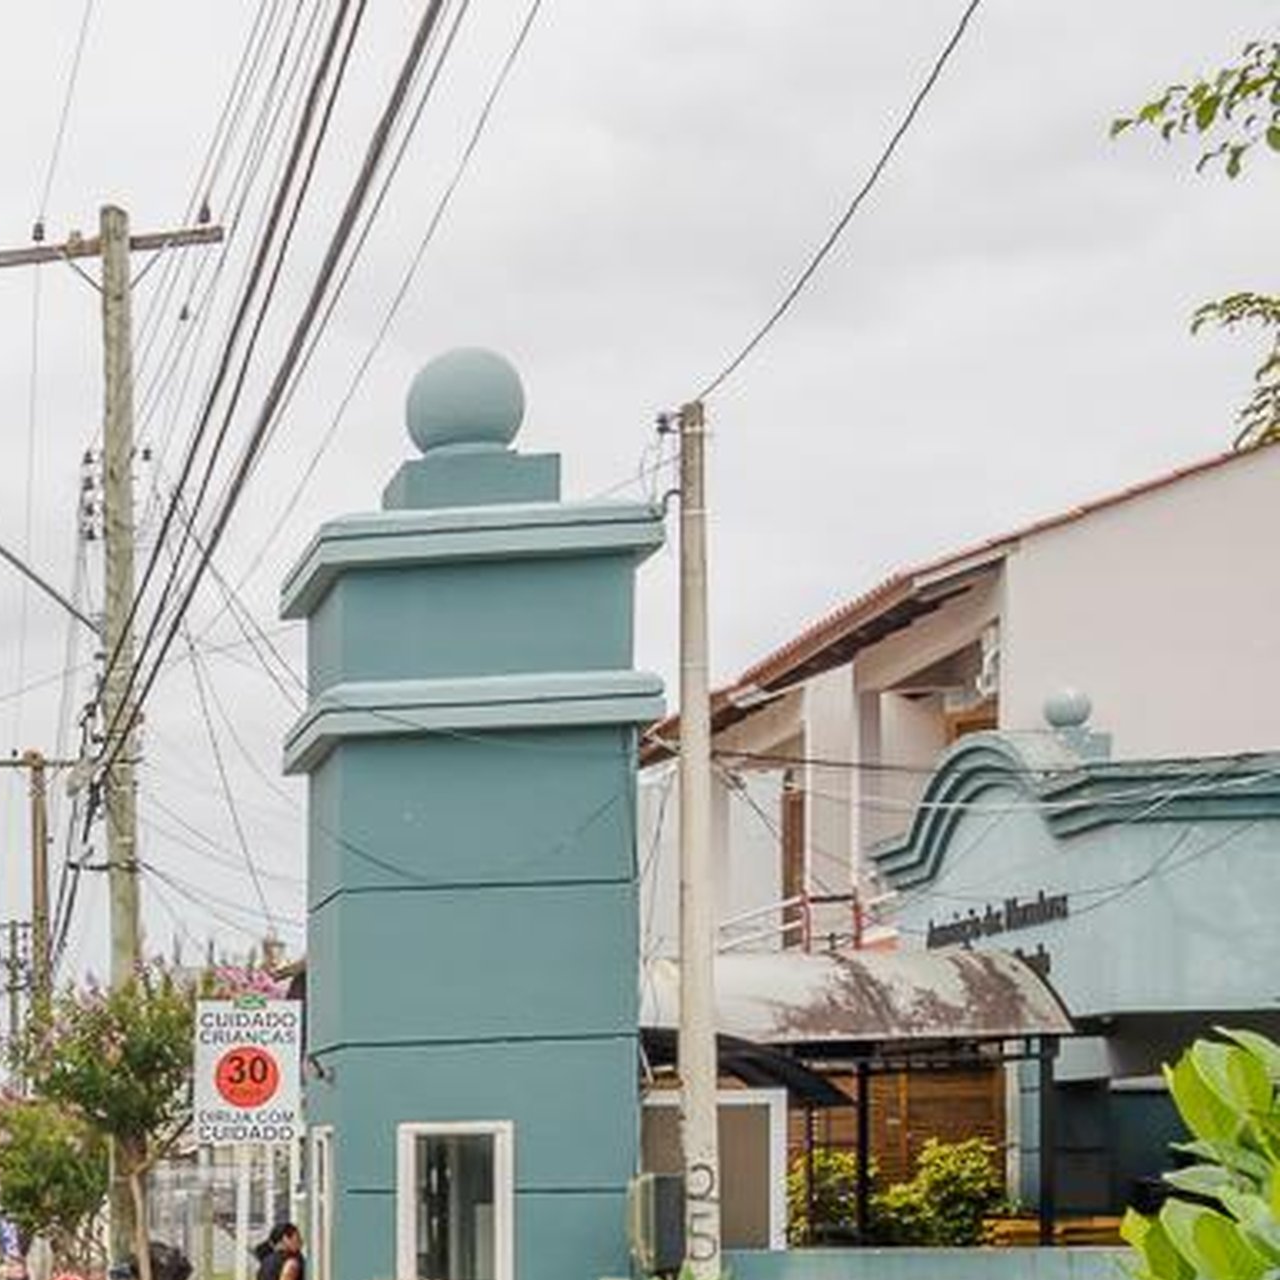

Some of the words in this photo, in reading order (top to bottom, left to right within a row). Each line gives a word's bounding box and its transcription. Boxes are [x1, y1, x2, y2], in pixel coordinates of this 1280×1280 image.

[199, 1012, 297, 1028] CUIDADO
[199, 1029, 296, 1046] CRIANÇAS
[227, 1055, 268, 1085] 30
[199, 1110, 253, 1124] DIRIJA
[256, 1110, 295, 1124] COM
[199, 1125, 295, 1141] CUIDADO
